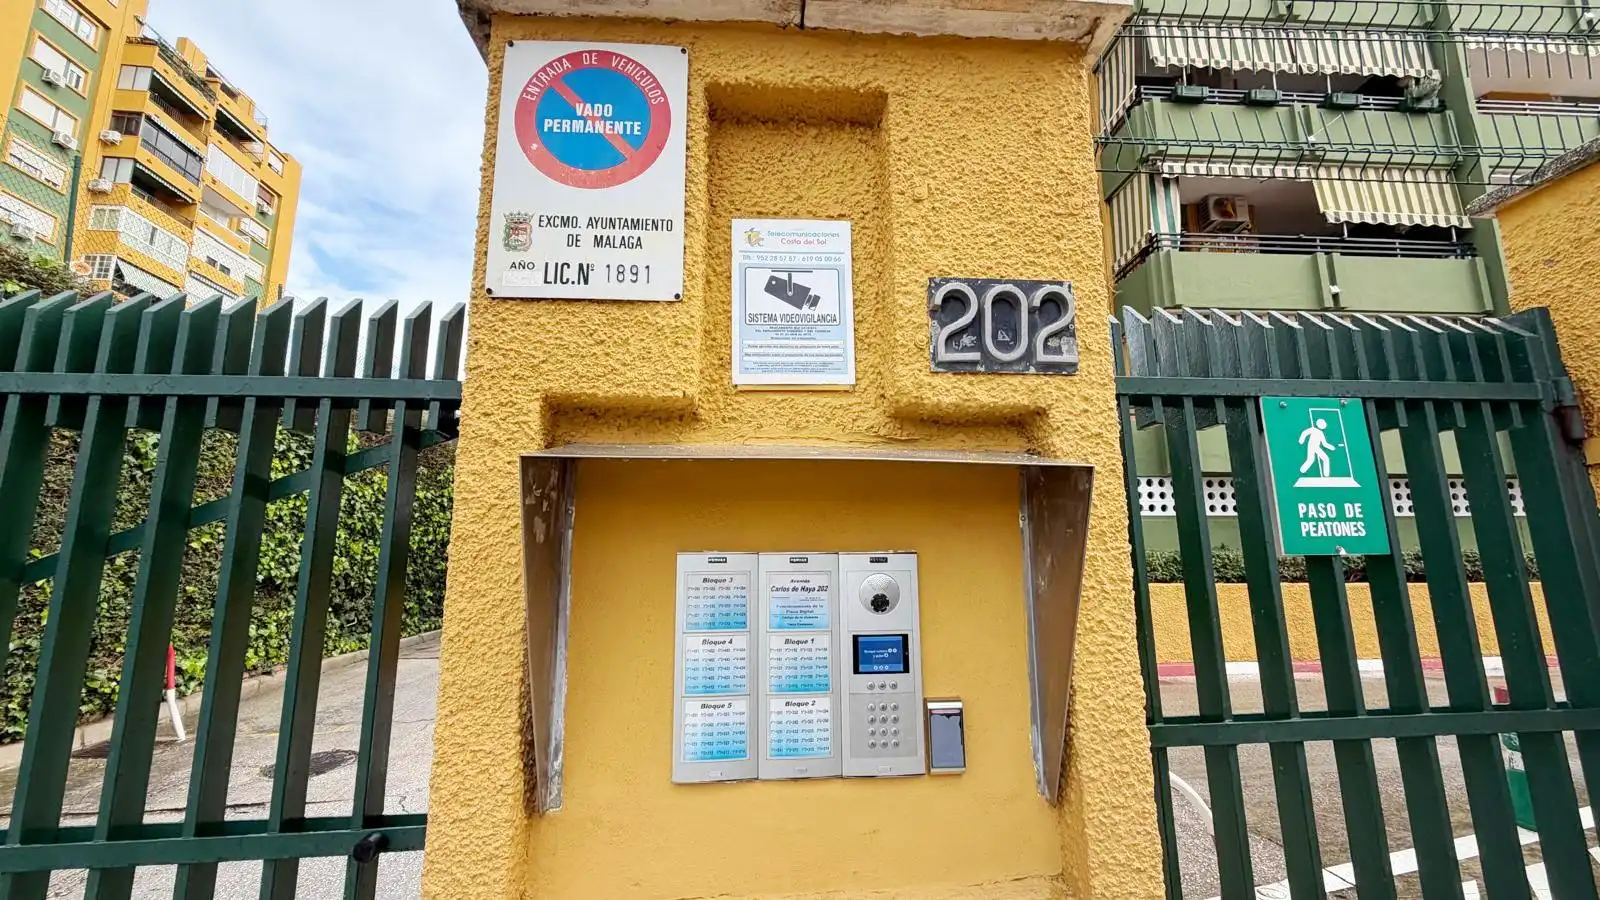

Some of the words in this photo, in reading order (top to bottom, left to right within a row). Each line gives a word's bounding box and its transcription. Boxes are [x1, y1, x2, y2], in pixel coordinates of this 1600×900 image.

[522, 58, 572, 101] ENTRADA
[582, 52, 598, 65] DE
[611, 55, 665, 105] VEHICULOS
[575, 103, 613, 117] VADO
[543, 118, 642, 135] PERMANENTE
[538, 214, 582, 229] EXCMO.
[586, 216, 673, 232] AYUNTAMIENTO
[566, 233, 581, 248] DE
[593, 234, 643, 250] MALAGA
[767, 230, 840, 238] Telecomunicaciones
[509, 260, 536, 271] AÑO
[605, 263, 651, 285] 1891
[748, 312, 778, 323] SISTEMA
[779, 313, 838, 324] VIDEOVIGILANCIA
[934, 282, 1079, 363] 202
[1297, 502, 1336, 519] PASO
[1344, 502, 1364, 519] DE
[1300, 521, 1367, 537] PEATONES
[702, 577, 727, 585] Bloque
[800, 585, 816, 593] Haya
[701, 638, 727, 646] Bloque
[784, 700, 810, 708] Bloque
